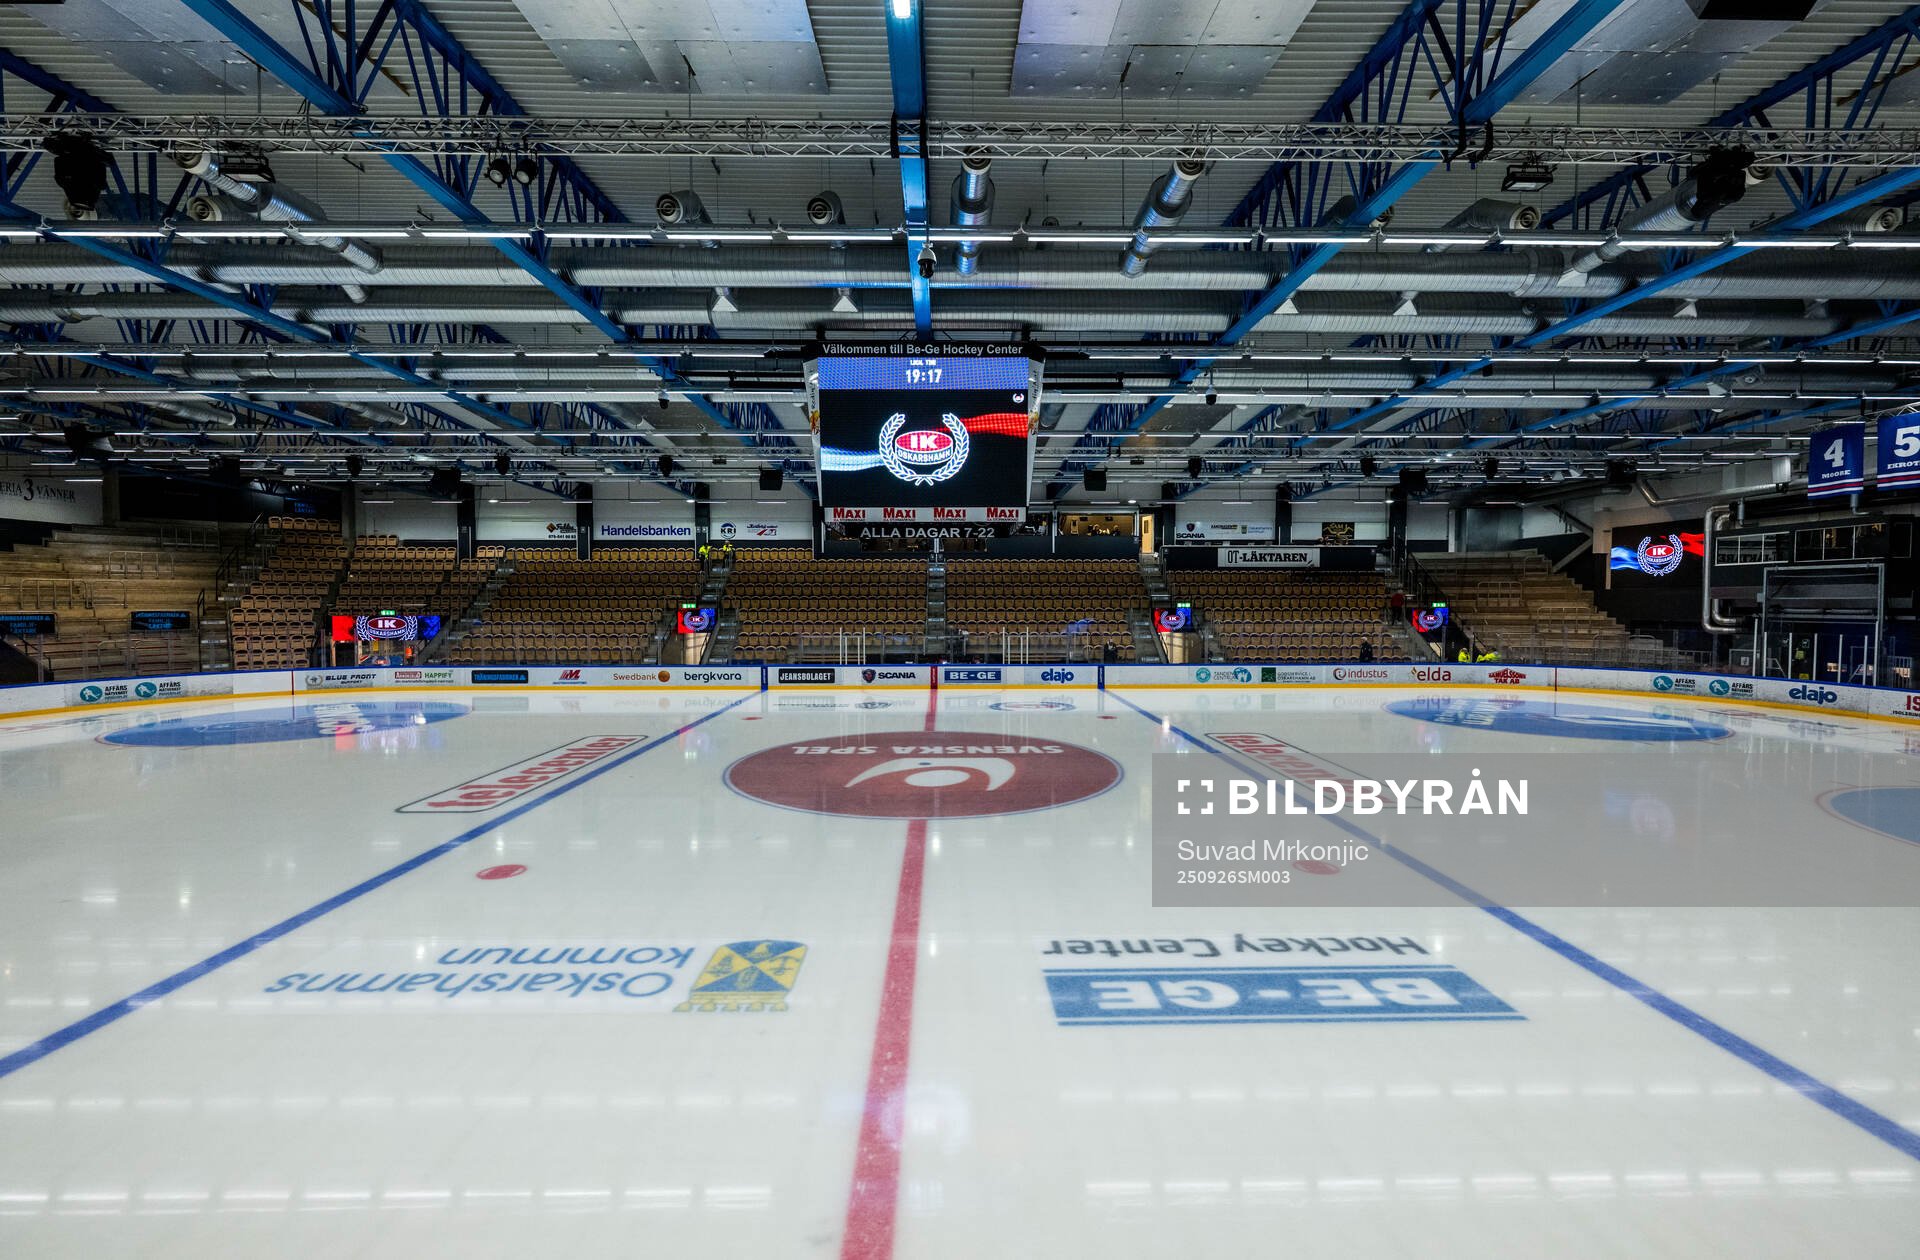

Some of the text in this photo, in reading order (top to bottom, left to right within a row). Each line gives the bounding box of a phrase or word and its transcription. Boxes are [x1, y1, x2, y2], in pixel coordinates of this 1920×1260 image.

[822, 343, 1023, 357] Välkommen till Be-Ge Hockey Center
[906, 368, 942, 384] 19:17
[910, 434, 938, 449] IK
[1893, 425, 1920, 458] 5
[897, 449, 951, 463] OSKARSHAMN
[1823, 438, 1845, 468] 4
[1821, 469, 1852, 479] MOORE
[23, 478, 34, 501] 3
[36, 484, 76, 500] VÄNNER
[601, 525, 691, 536] Handelsbanken
[860, 527, 995, 538] ALLA DAGAR 7-22
[1652, 547, 1667, 556] IK
[377, 619, 397, 629] IK
[613, 672, 657, 681] Swedbank
[684, 671, 742, 684] bergkvara
[780, 671, 832, 682] JEANSBOLAGET
[877, 671, 917, 680] SCANIA
[1041, 668, 1075, 683] elajo
[1348, 668, 1388, 679] industus
[1416, 667, 1452, 682] elda
[1788, 684, 1838, 705] elajo
[791, 745, 1066, 755] SVENSKA SPEL
[427, 736, 637, 808] telecenter
[1042, 935, 1431, 959] Hockey Center
[436, 946, 696, 968] kommun
[262, 970, 675, 999] Oskarshamns
